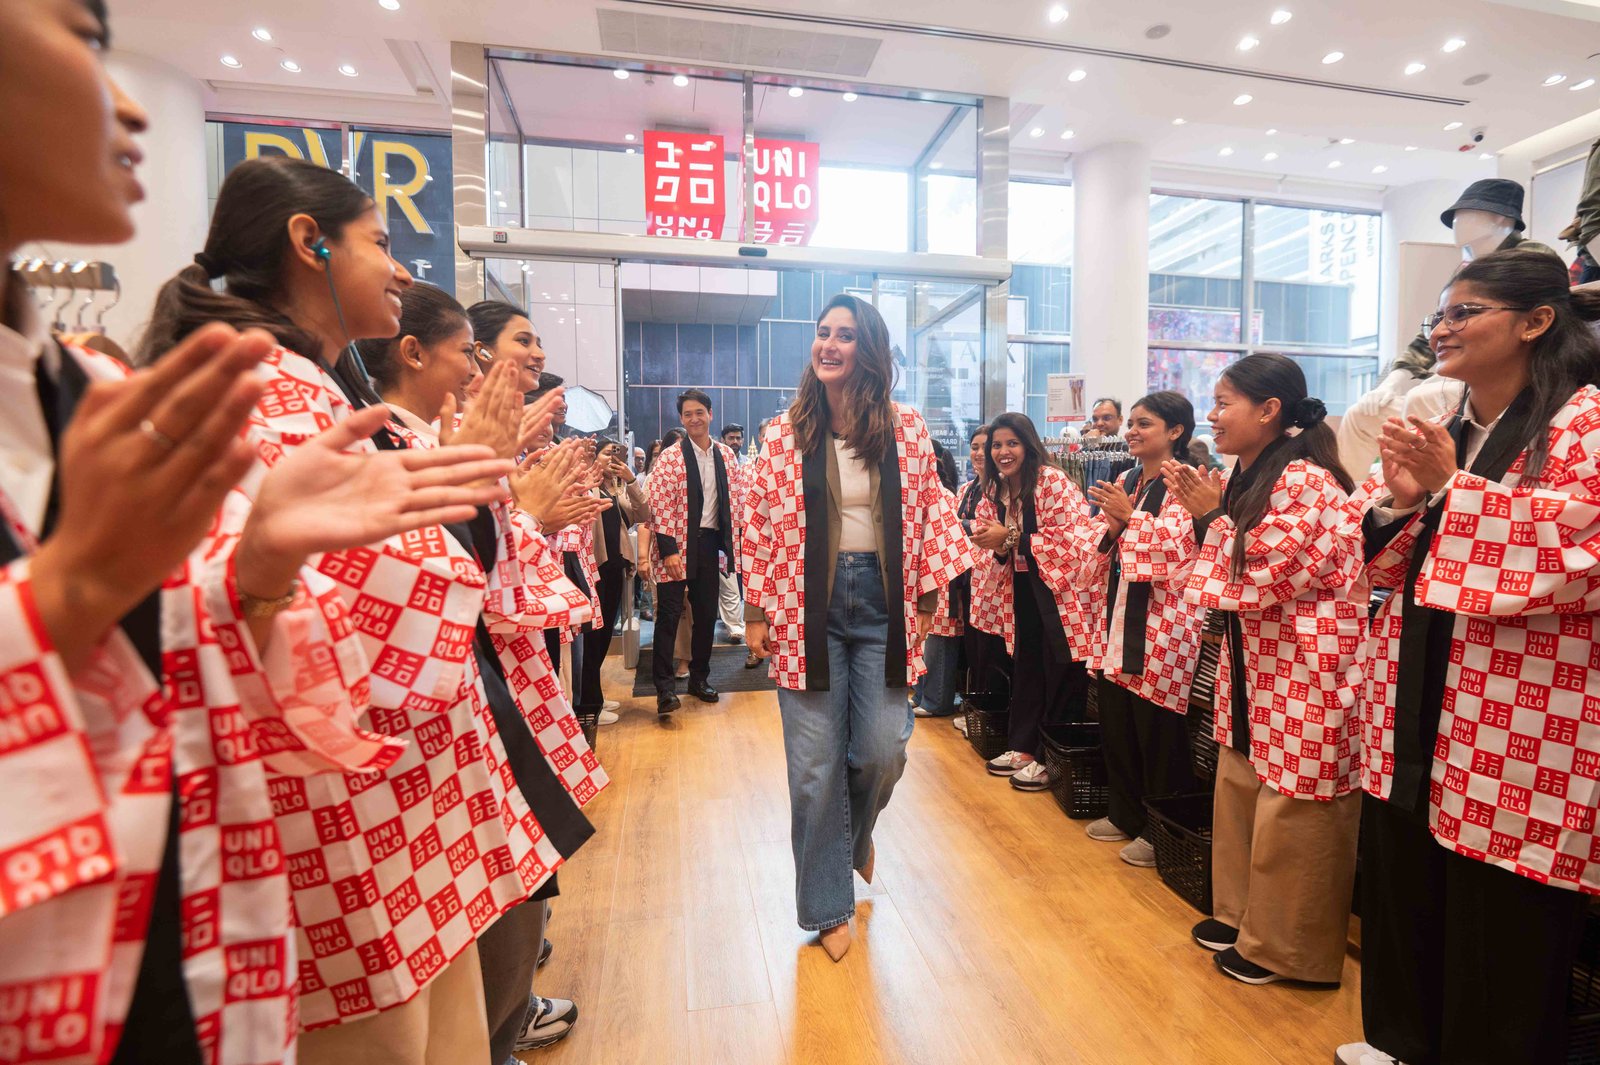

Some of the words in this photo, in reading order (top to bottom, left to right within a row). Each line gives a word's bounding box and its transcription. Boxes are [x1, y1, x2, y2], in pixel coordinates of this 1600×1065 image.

[656, 142, 714, 171] ユニ
[754, 149, 806, 177] UNI
[654, 176, 714, 204] クロ
[754, 181, 811, 213] QLO
[656, 216, 710, 229] UNI
[784, 521, 797, 529] QLO
[1451, 514, 1474, 524] UNI
[1448, 523, 1473, 534] QLO
[1513, 532, 1536, 542] QLO
[1277, 539, 1292, 551] UNI
[1438, 561, 1462, 571] UNI
[1436, 570, 1461, 580] QLO
[1503, 571, 1529, 581] UNI
[1501, 580, 1528, 592] QLO
[1224, 590, 1240, 598] QLO
[358, 599, 393, 621] UNI
[1297, 609, 1314, 618] QLO
[1336, 610, 1354, 618] QLO
[352, 613, 388, 635] QLO
[1470, 621, 1491, 633] UNI
[440, 625, 468, 643] UNI
[1468, 632, 1491, 644] QLO
[1529, 633, 1552, 645] UNI
[436, 641, 466, 659] QLO
[1528, 644, 1553, 656] QLO
[1462, 670, 1481, 682] UNI
[1461, 681, 1481, 693] QLO
[1520, 685, 1544, 697] UNI
[1307, 705, 1323, 714] UNI
[1518, 696, 1544, 708] QLO
[530, 709, 545, 724] UNI
[534, 716, 551, 731] QLO
[1306, 713, 1323, 723] QLO
[417, 719, 446, 741] UNI
[1455, 719, 1472, 732] UNI
[1453, 730, 1472, 743] QLO
[1511, 735, 1535, 749] UNI
[423, 732, 452, 757] QLO
[1302, 741, 1319, 750] UNI
[552, 746, 569, 762] UNI
[1302, 749, 1319, 758] QLO
[1509, 748, 1535, 761] QLO
[558, 754, 575, 770] QLO
[1448, 767, 1463, 781] UNI
[433, 779, 455, 802] UNI
[575, 780, 590, 796] UNI
[1445, 778, 1464, 791] QLO
[1502, 785, 1526, 799] UNI
[435, 791, 460, 814] QLO
[579, 788, 596, 803] QLO
[1501, 797, 1526, 811] QLO
[1568, 805, 1590, 819] UNI
[1439, 813, 1455, 829] UNI
[1566, 817, 1590, 830] QLO
[224, 825, 274, 852] UNI
[368, 822, 398, 845] UNI
[372, 835, 403, 859] QLO
[449, 838, 471, 860] UNI
[1493, 835, 1516, 848] UNI
[1491, 846, 1516, 858] QLO
[225, 849, 279, 878] QLO
[452, 849, 475, 872] QLO
[519, 856, 535, 877] UNI
[1556, 856, 1579, 869] UNI
[291, 868, 324, 886] QLO
[524, 866, 543, 886] QLO
[1554, 867, 1577, 879] QLO
[386, 883, 412, 909] UNI
[391, 895, 417, 920] QLO
[468, 893, 488, 917] UNI
[472, 904, 492, 928] QLO
[310, 923, 339, 940] UNI
[314, 936, 347, 955] QLO
[228, 944, 277, 971] UNI
[411, 942, 436, 969] UNI
[415, 956, 442, 980] QLO
[228, 968, 282, 997] QLO
[335, 982, 363, 998] UNI
[339, 996, 370, 1014] QLO
